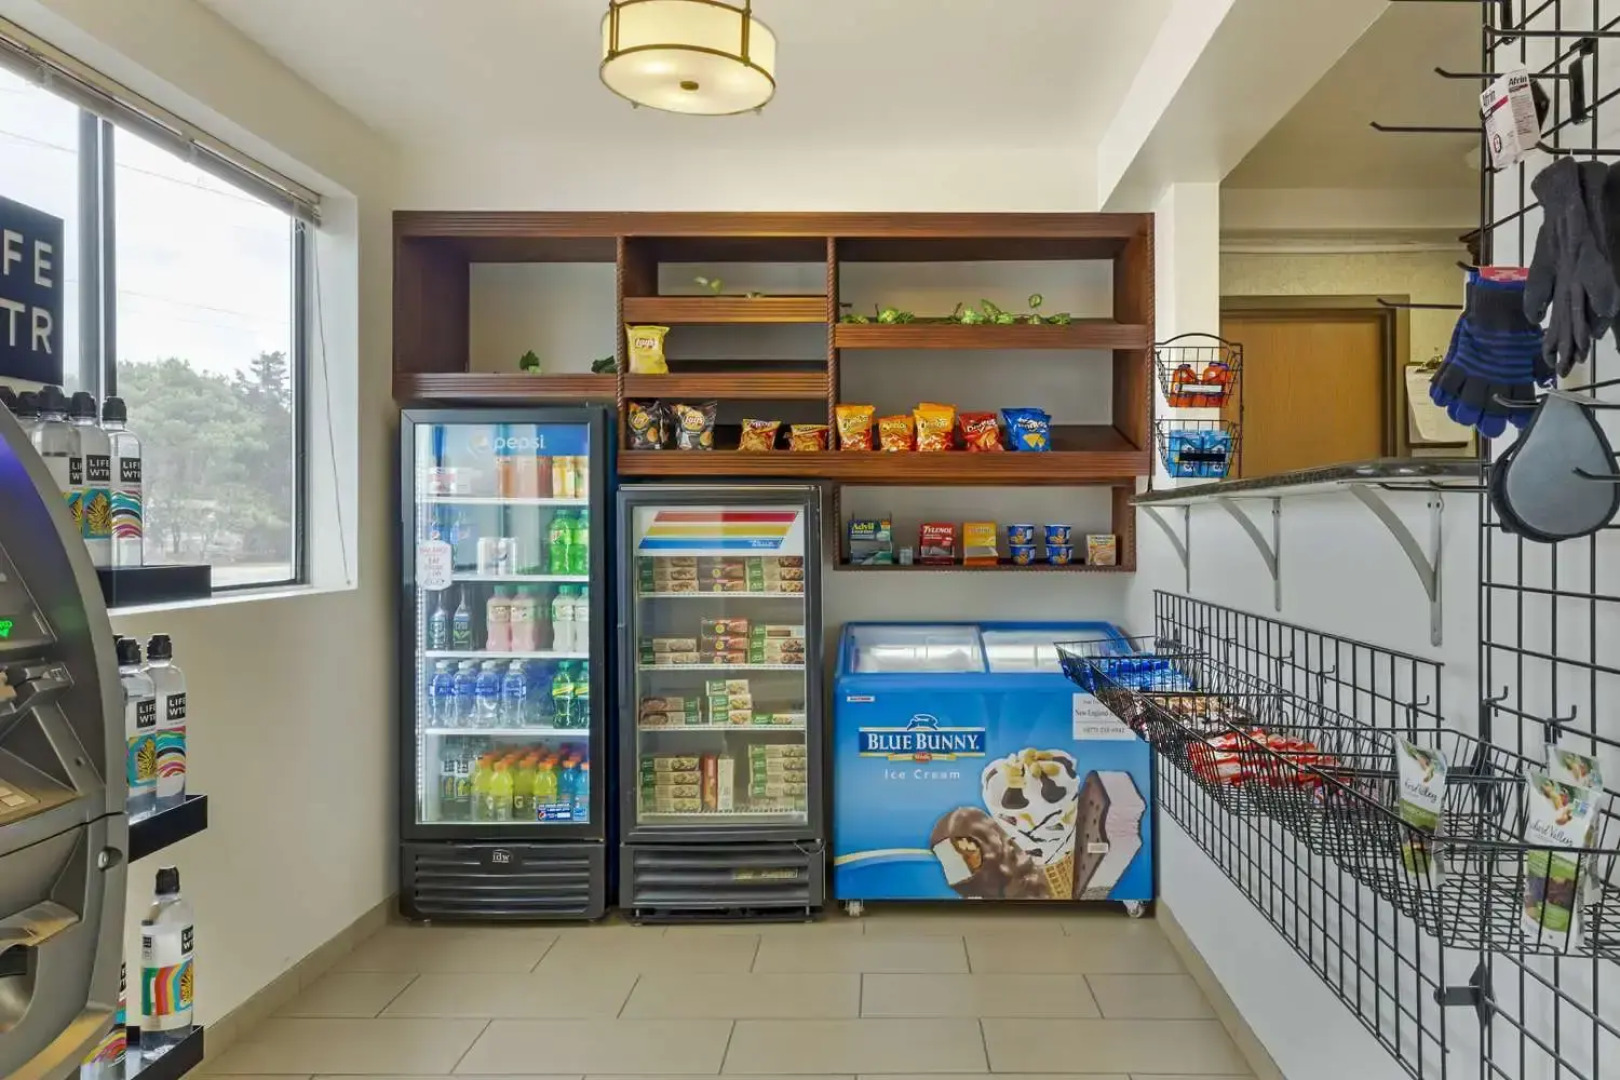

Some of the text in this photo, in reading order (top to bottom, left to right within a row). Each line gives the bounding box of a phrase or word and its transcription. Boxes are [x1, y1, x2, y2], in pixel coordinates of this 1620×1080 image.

[1509, 76, 1527, 86] Afrin
[3, 228, 53, 288] FE
[0, 297, 53, 354] TR
[494, 434, 544, 451] pepsi
[71, 461, 82, 470] LI
[852, 522, 875, 531] Advil
[867, 733, 912, 750] BLUE
[884, 768, 960, 779] Ice Cream
